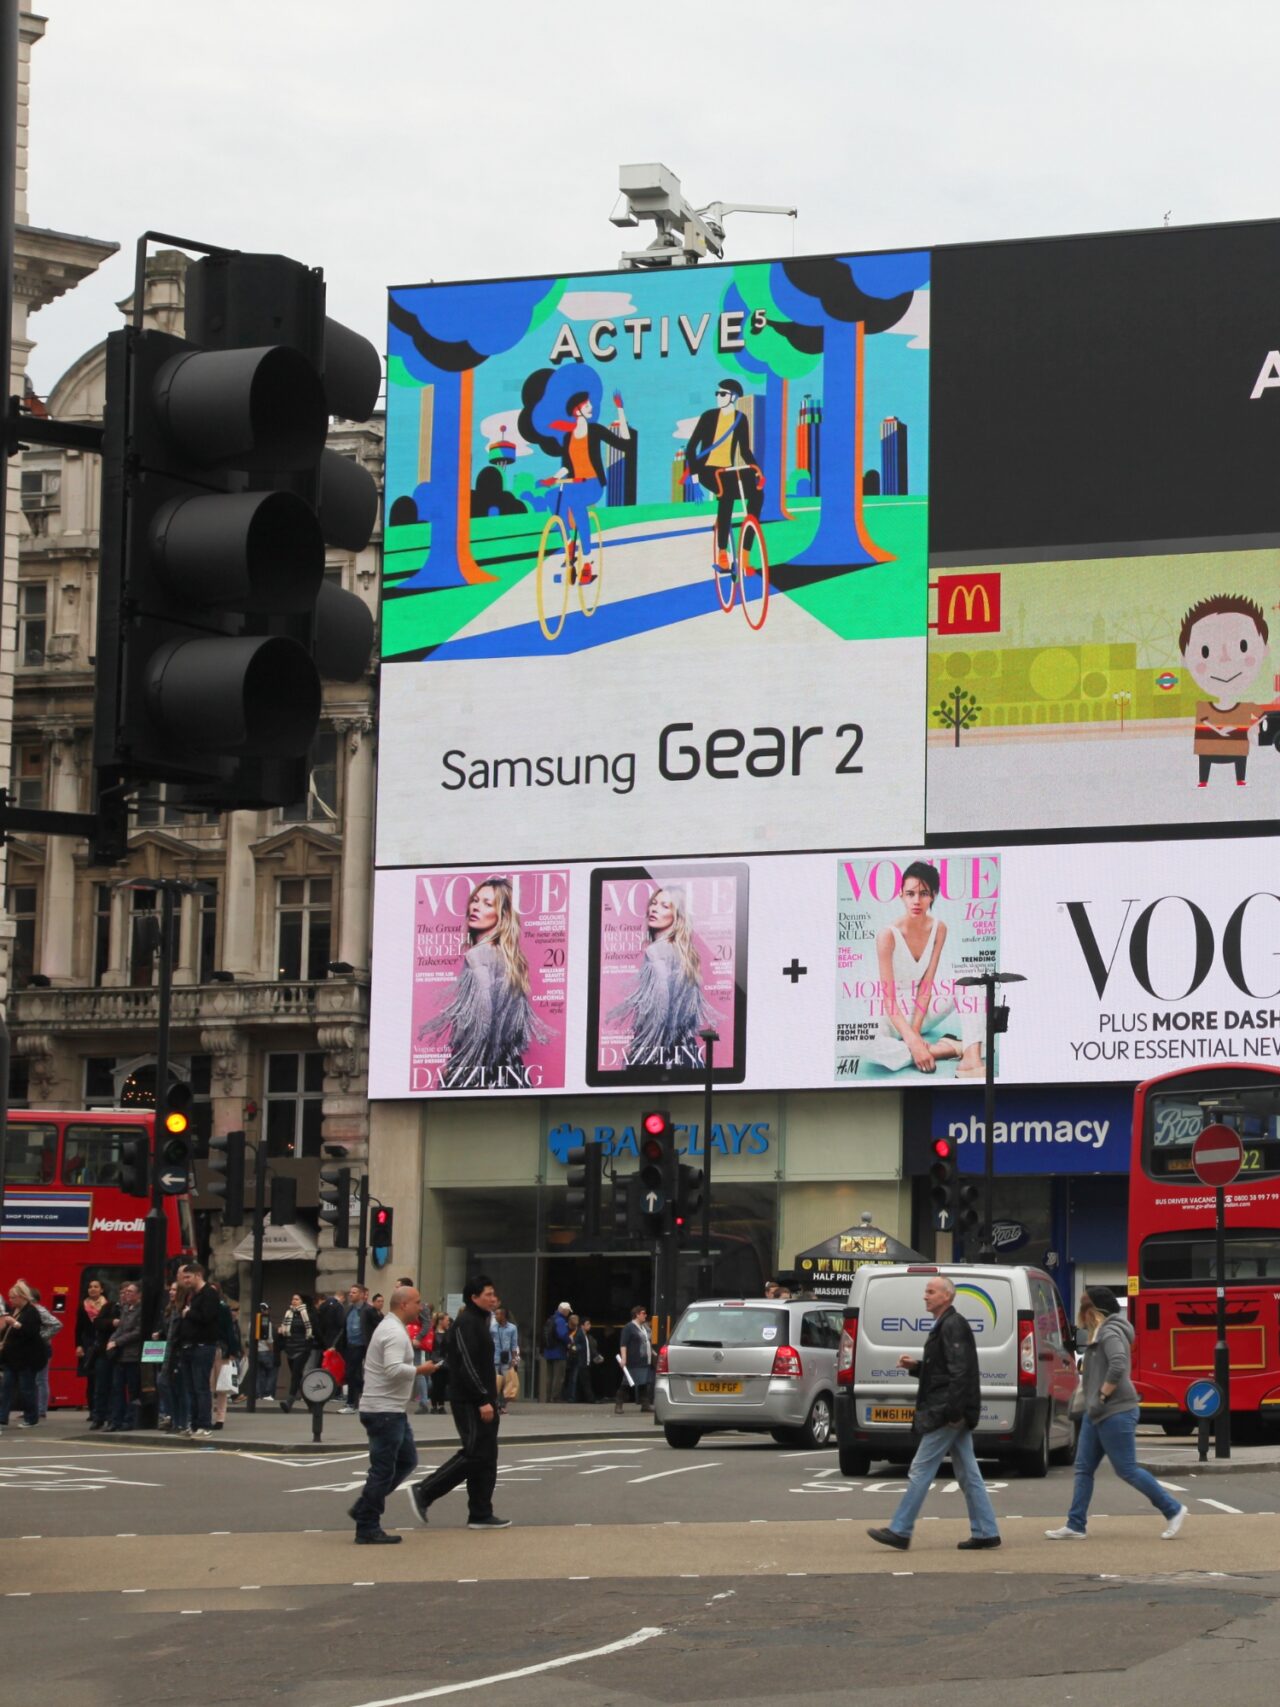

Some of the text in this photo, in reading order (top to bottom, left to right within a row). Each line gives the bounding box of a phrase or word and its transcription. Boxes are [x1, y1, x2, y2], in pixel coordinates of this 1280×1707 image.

[441, 722, 864, 795] Samsung Gear 2
[840, 857, 999, 903] VOUE
[418, 872, 568, 917] VOUE
[603, 880, 734, 917] VOUE
[964, 902, 997, 921] 164
[417, 924, 461, 934] The Great
[604, 924, 642, 932] The Great
[838, 921, 866, 931] NEW
[838, 931, 875, 941] RULES
[416, 945, 463, 956] MODEL
[544, 948, 565, 967] 20
[713, 944, 733, 961] 20
[842, 979, 902, 999] MORE
[864, 998, 928, 1017] THAN
[1099, 1012, 1148, 1033] PLUS
[1152, 1010, 1218, 1031] MORE
[1070, 1040, 1129, 1061] YOUR
[1135, 1037, 1239, 1059] ESSENTIAL
[837, 1058, 861, 1075] H&M
[413, 1064, 544, 1089] DAZZLING
[948, 1115, 1110, 1148] pharmacy
[1154, 1107, 1203, 1147] Boo
[594, 1123, 769, 1157] BACLAYS
[1168, 1197, 1188, 1205] DRIVER
[92, 1217, 146, 1232] Metroli
[818, 1258, 830, 1271] WE
[832, 1258, 852, 1272] WILL
[813, 1272, 855, 1281] HALF PRIC
[813, 1287, 850, 1296] 'MASSIVEL
[881, 1318, 984, 1332] ENEG
[871, 1369, 908, 1377] ENER-
[698, 1382, 739, 1392] LL09 FGF
[874, 1407, 916, 1419] MW61 HM
